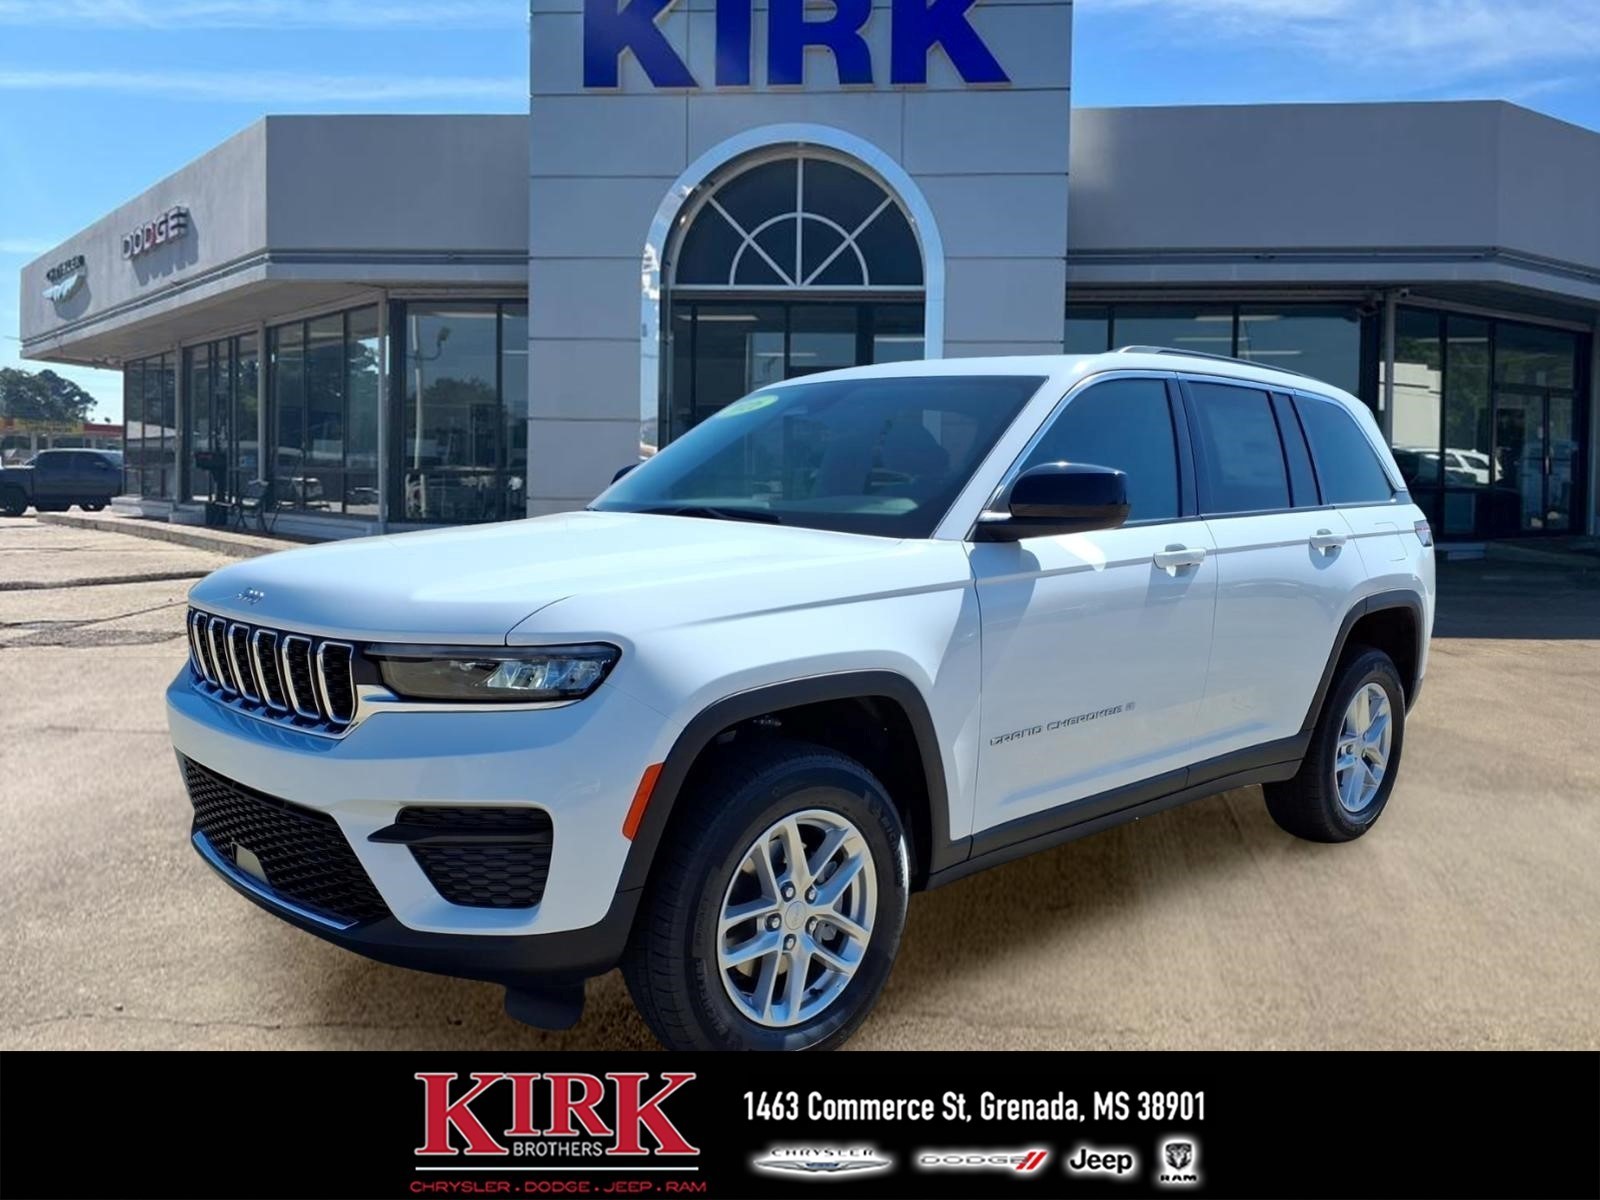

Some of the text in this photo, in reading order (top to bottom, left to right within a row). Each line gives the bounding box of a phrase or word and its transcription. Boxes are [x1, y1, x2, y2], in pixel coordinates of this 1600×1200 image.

[583, 0, 1011, 88] KIRK
[121, 206, 188, 260] DODGE
[990, 704, 1123, 746] GRAND CHEROKEE
